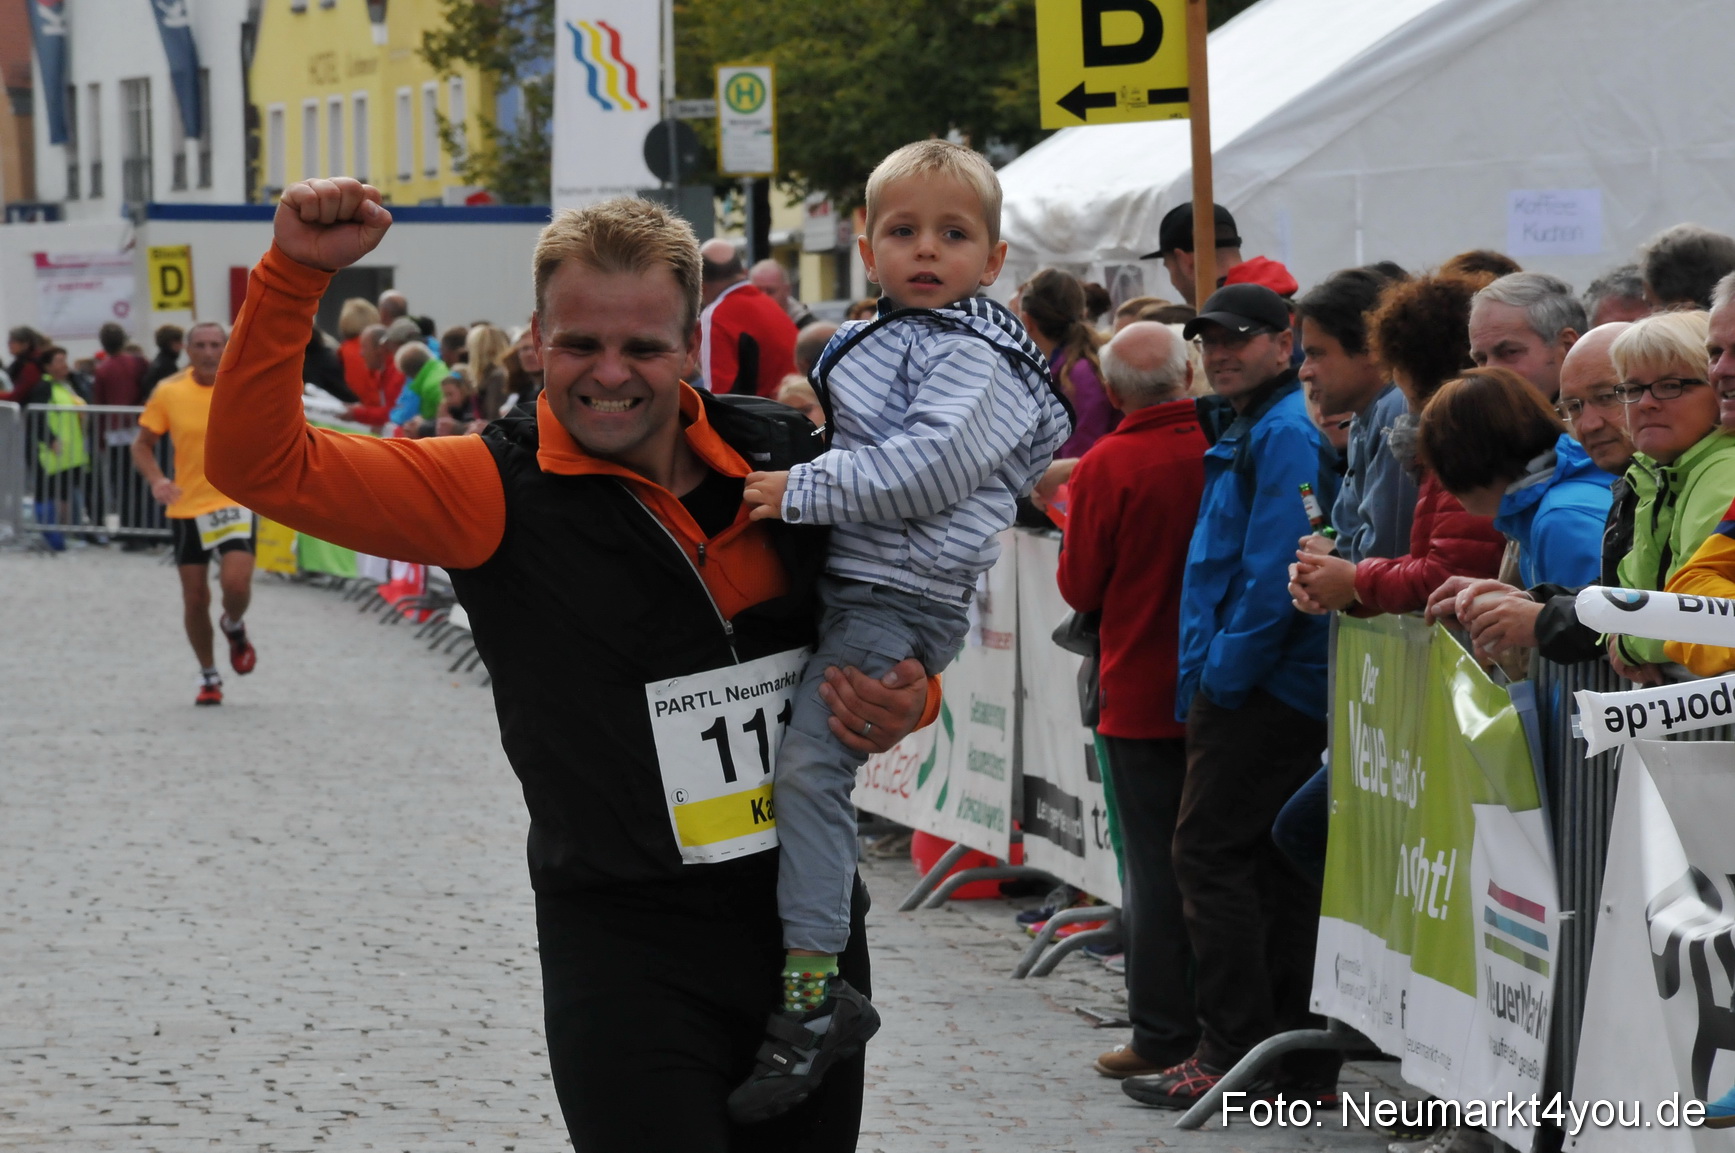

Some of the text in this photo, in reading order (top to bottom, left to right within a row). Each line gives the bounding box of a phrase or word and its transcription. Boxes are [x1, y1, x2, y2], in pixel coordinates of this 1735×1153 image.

[1081, 0, 1164, 68] D
[160, 264, 184, 297] D
[655, 671, 797, 718] PARTL Neumarkt
[1604, 681, 1735, 738] port.de
[1349, 700, 1388, 798] Neue
